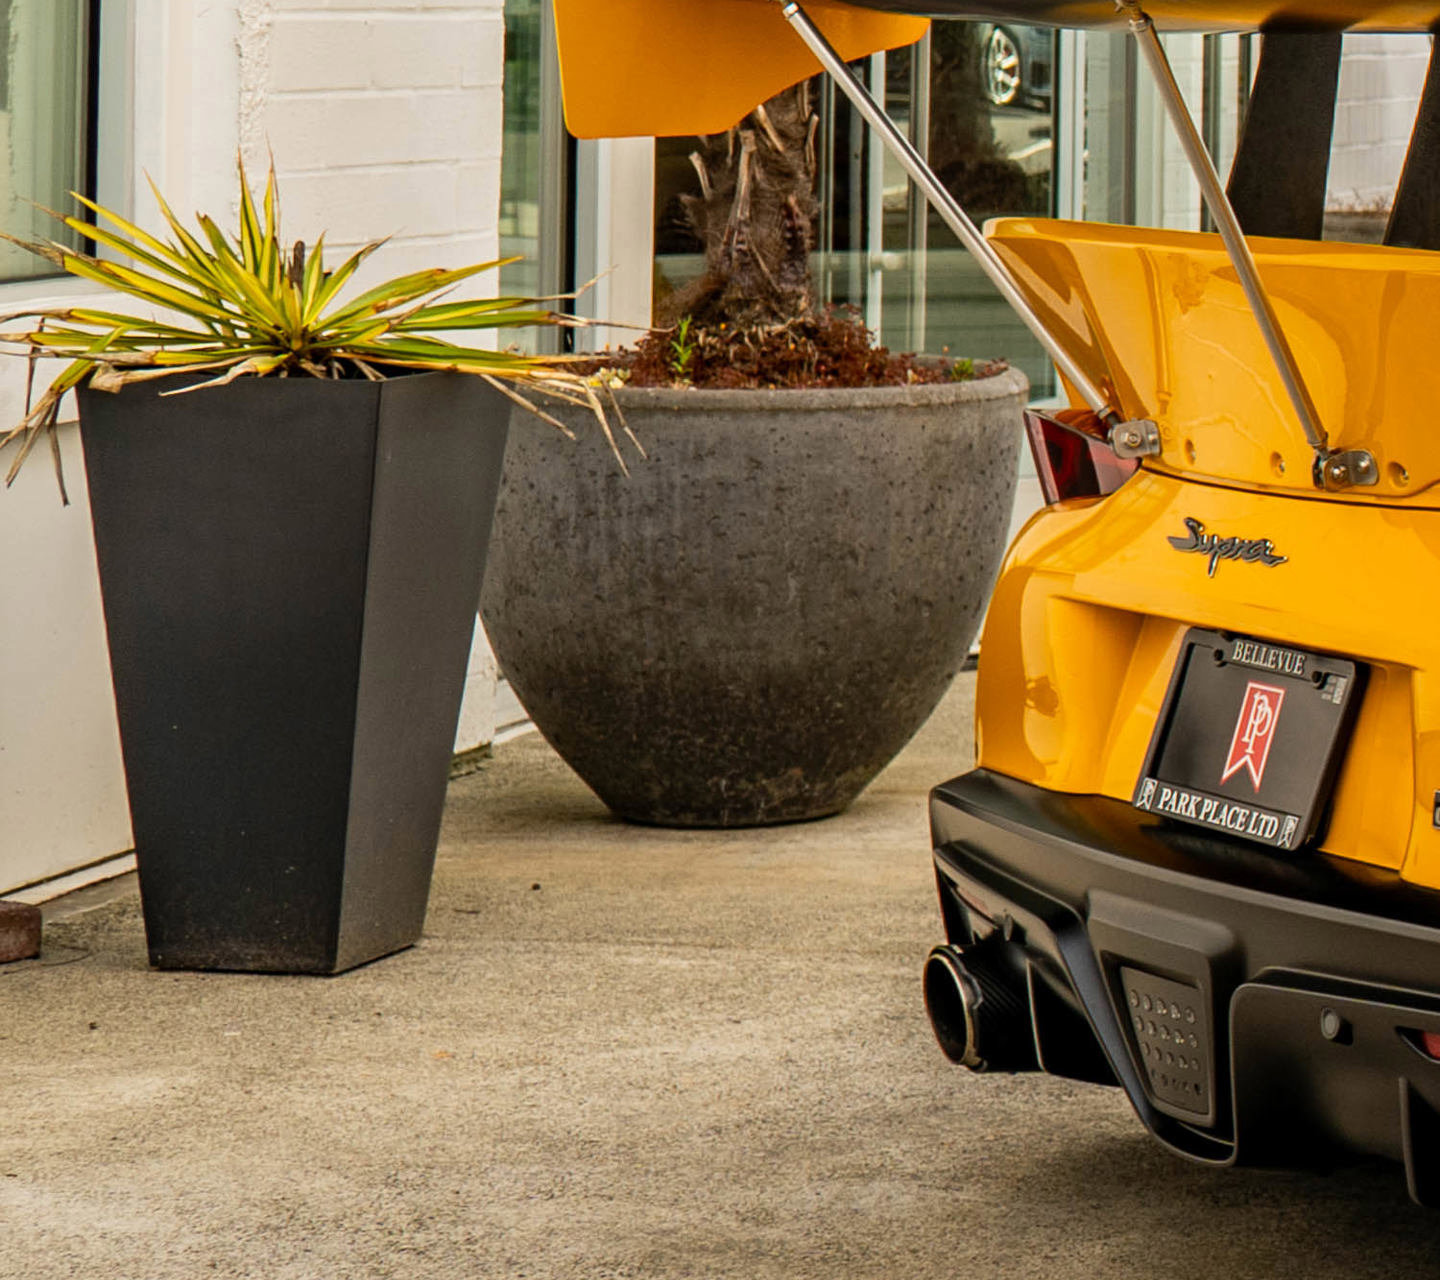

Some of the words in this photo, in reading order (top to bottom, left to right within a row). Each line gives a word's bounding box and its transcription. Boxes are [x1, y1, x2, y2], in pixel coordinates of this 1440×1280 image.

[1167, 517, 1289, 578] Supra
[1232, 641, 1307, 675] BELLEVUE
[1157, 787, 1202, 825] PARK
[1198, 797, 1250, 833] PLACE
[1243, 812, 1279, 840] LTD
